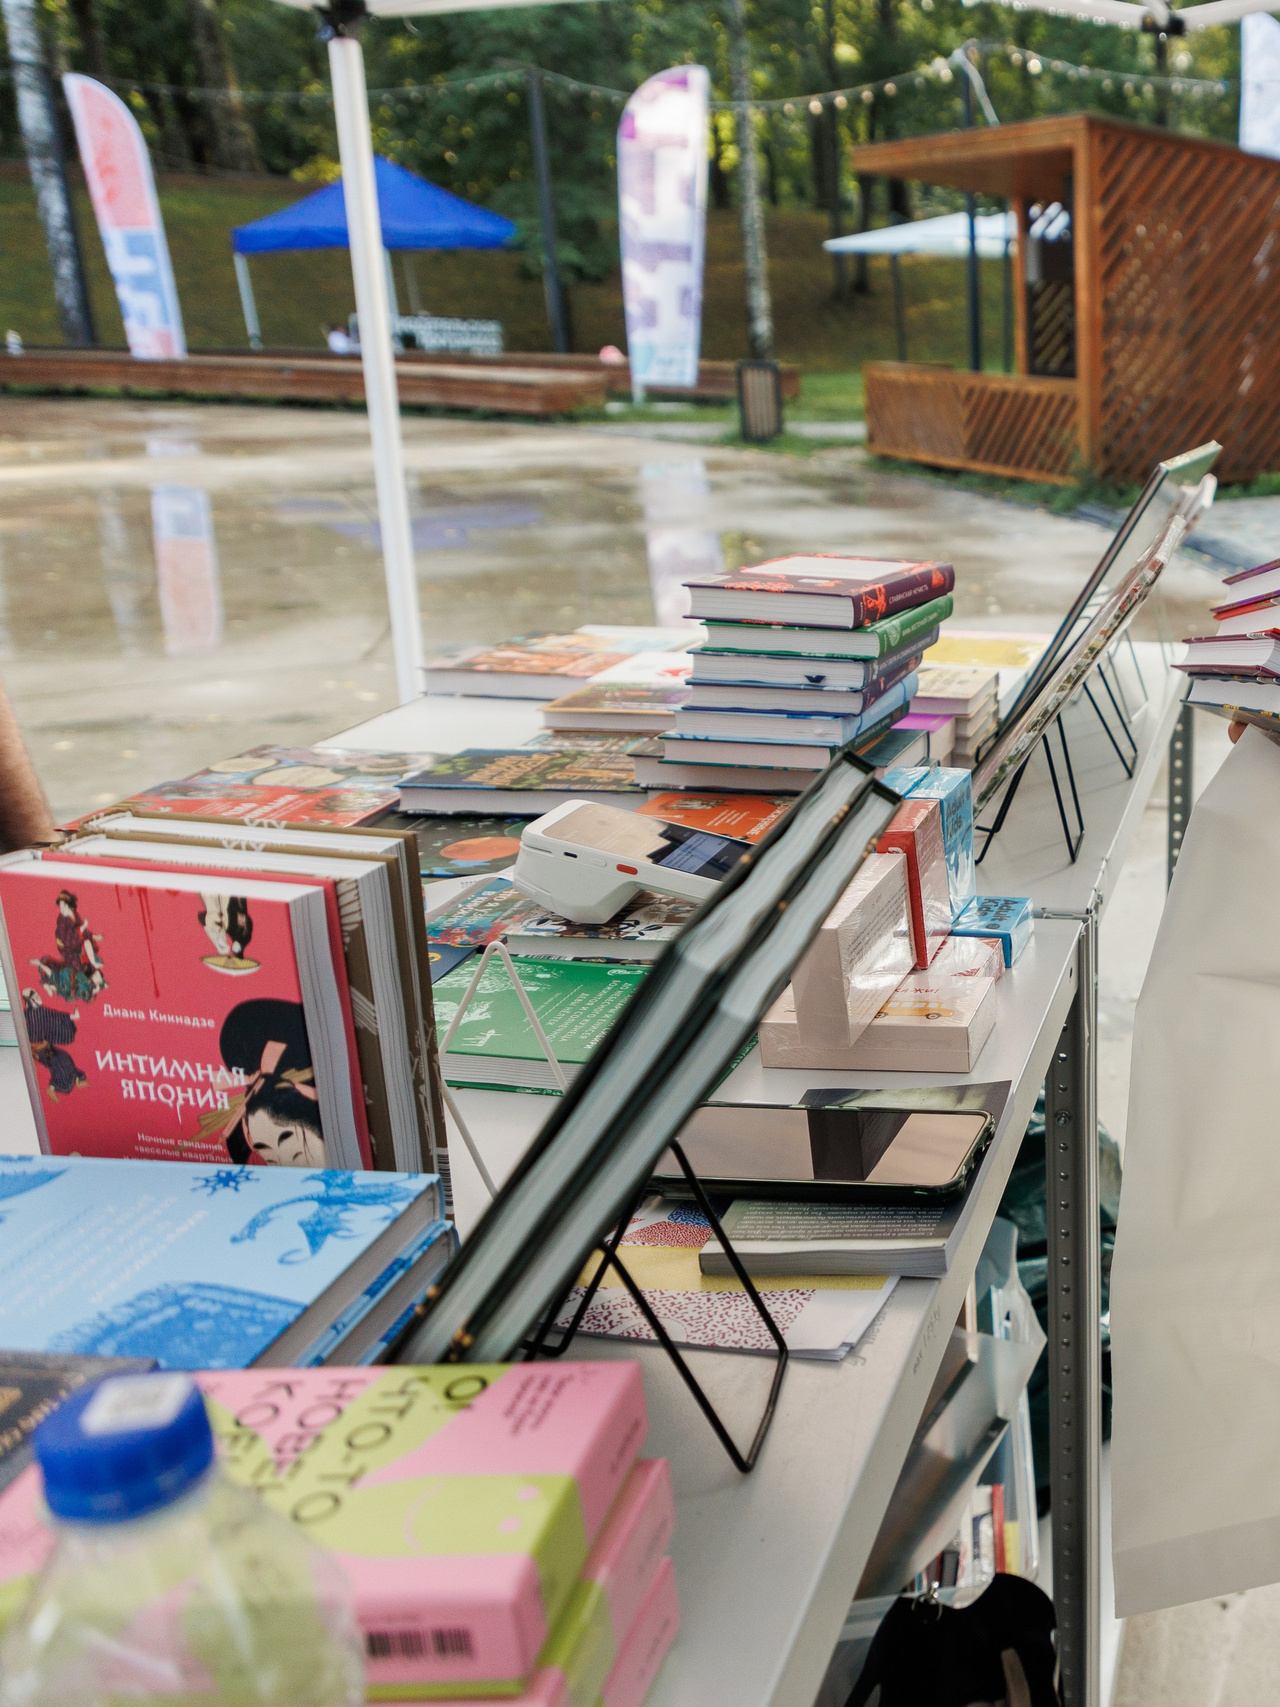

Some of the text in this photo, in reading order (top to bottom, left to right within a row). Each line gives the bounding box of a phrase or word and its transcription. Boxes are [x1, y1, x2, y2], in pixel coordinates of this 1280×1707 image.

[977, 898, 1000, 917] Kids
[991, 899, 1020, 925] Adult
[103, 1003, 215, 1030] Диана Кикнадзе
[95, 1049, 246, 1087] ИНТИМНАЯ
[121, 1078, 230, 1124] ЯПОНИЯ
[137, 1132, 175, 1147] Ночные
